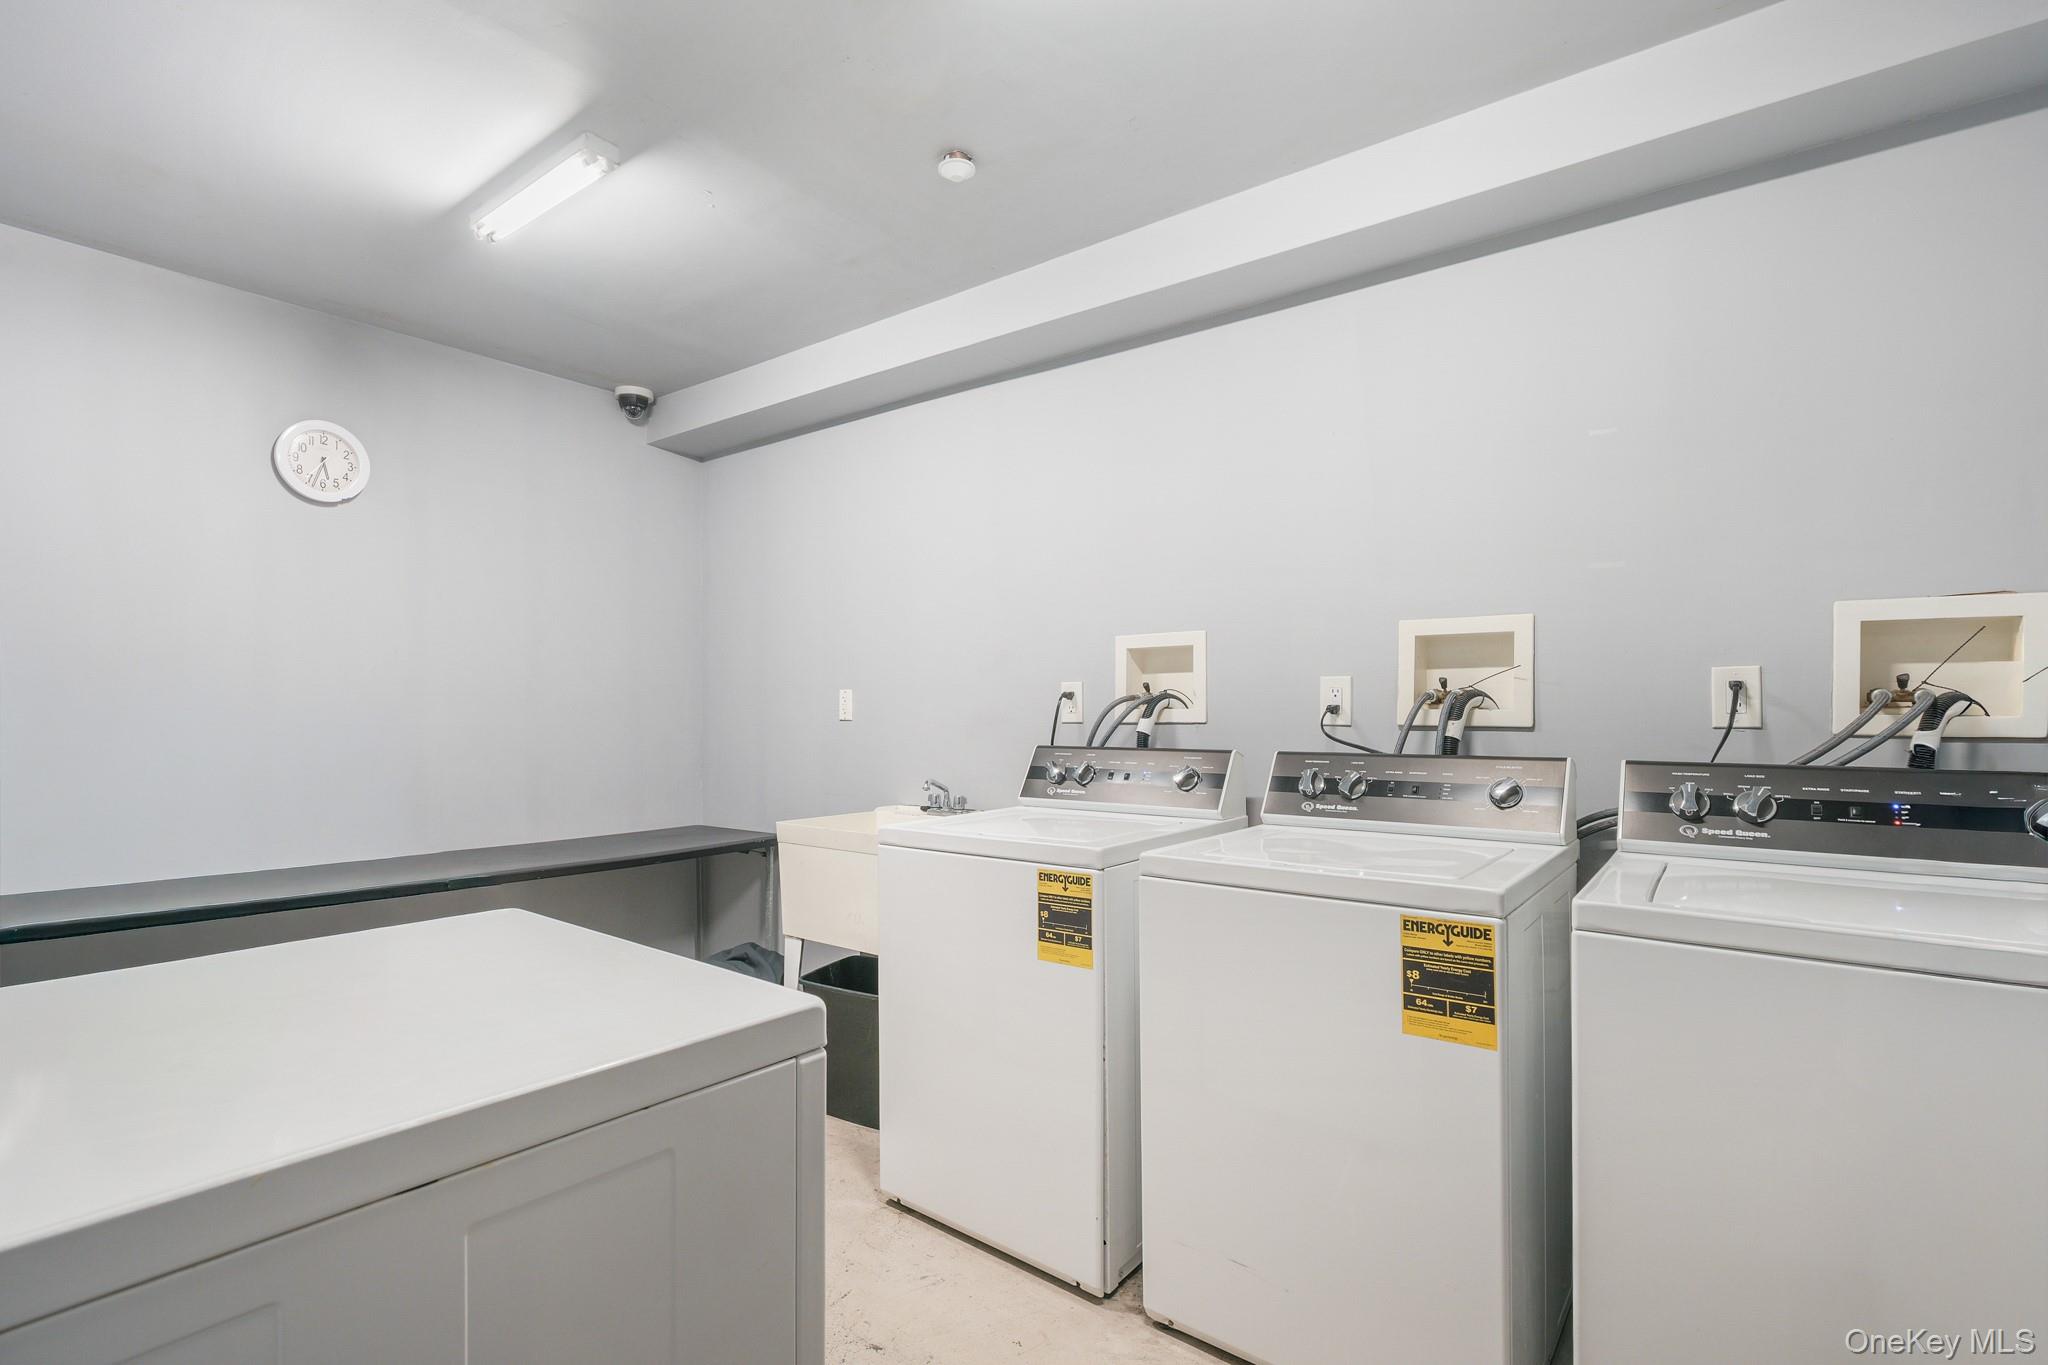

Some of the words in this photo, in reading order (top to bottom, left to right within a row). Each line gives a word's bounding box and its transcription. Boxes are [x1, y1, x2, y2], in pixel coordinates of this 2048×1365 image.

[308, 435, 315, 446] 11
[319, 434, 328, 446] 12
[298, 442, 308, 453] 10
[292, 452, 299, 462] 9
[343, 450, 350, 460] 2
[296, 464, 303, 475] 8
[347, 462, 354, 472] 3
[342, 472, 349, 482] 4
[319, 479, 327, 489] 6
[332, 478, 340, 488] 5
[1702, 827, 1734, 836] Speed
[1038, 871, 1092, 888] ENERGYGUIDE
[1402, 919, 1492, 942] ENERGYGUIDE
[1406, 969, 1420, 980] $8
[1415, 998, 1428, 1006] 64
[1465, 1005, 1478, 1014] $7
